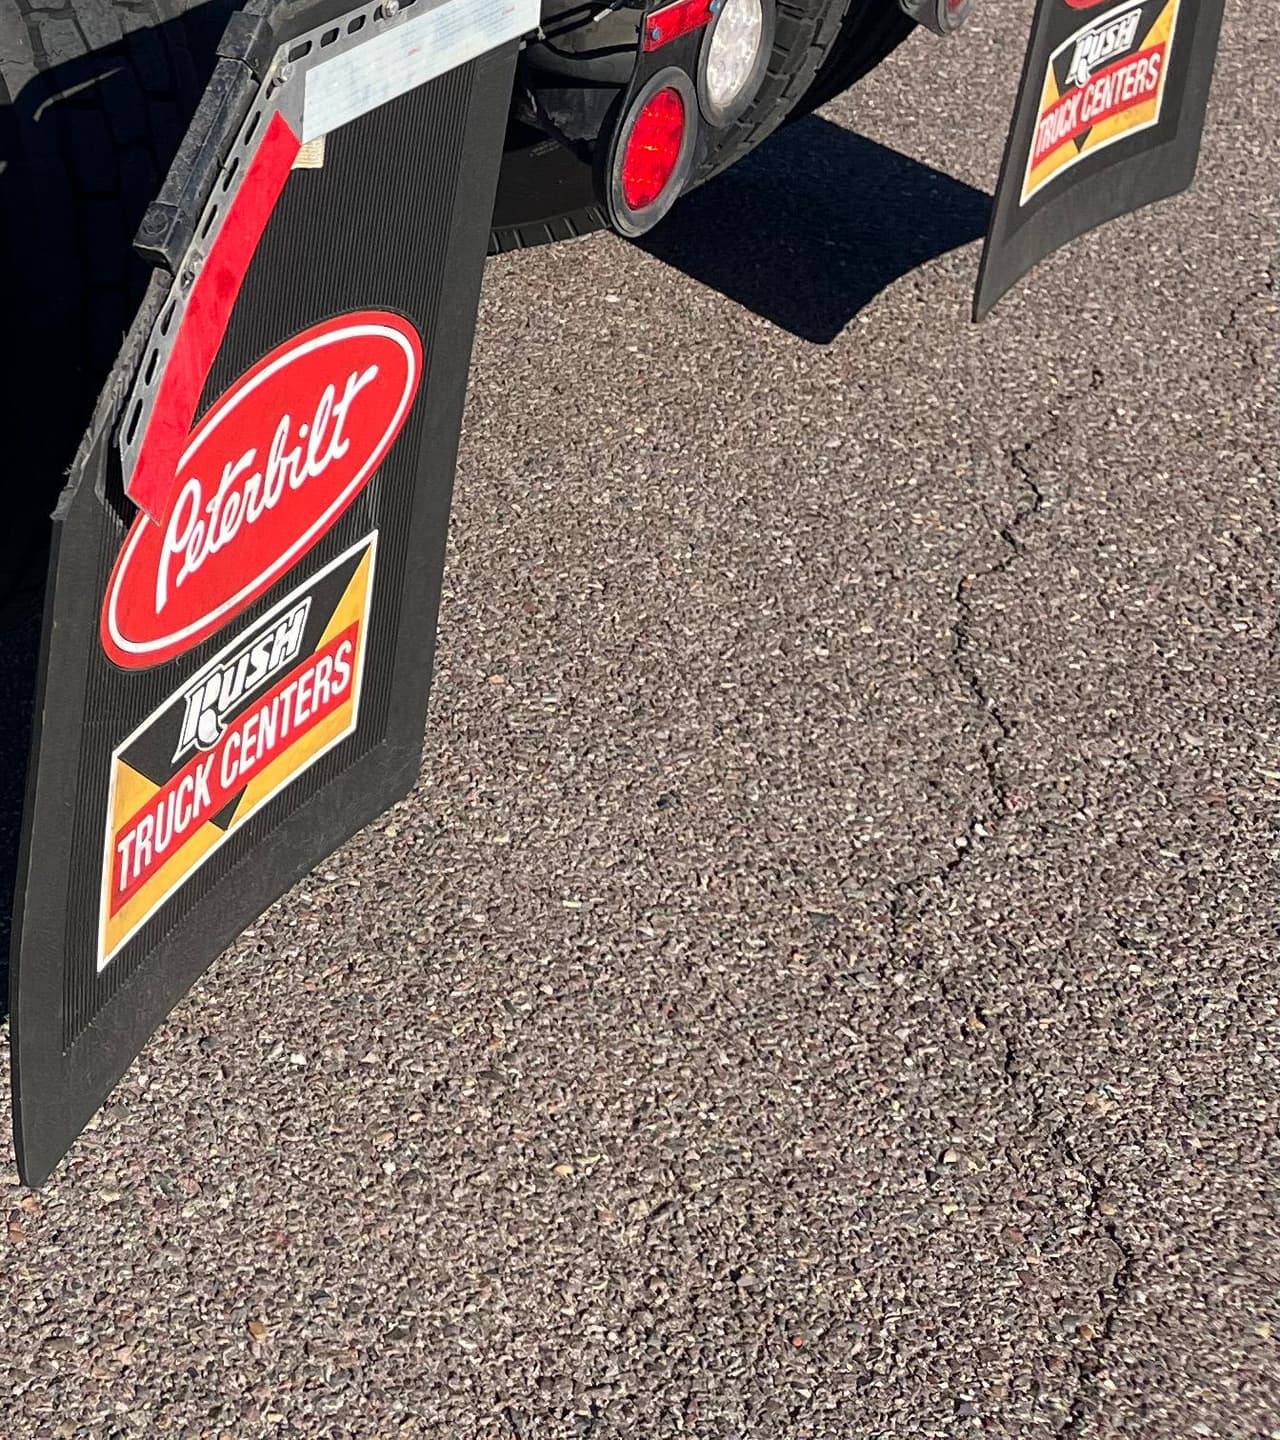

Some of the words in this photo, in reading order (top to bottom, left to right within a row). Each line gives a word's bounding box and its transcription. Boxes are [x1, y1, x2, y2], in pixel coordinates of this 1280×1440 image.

[1035, 86, 1081, 159] TRUCK
[1081, 52, 1162, 122] CENTERS
[1065, 7, 1143, 88] RUSH
[154, 364, 379, 616] Peterbilt
[170, 596, 313, 766] RUSH
[117, 767, 213, 894] TRUCK
[220, 639, 354, 789] CENTERS
